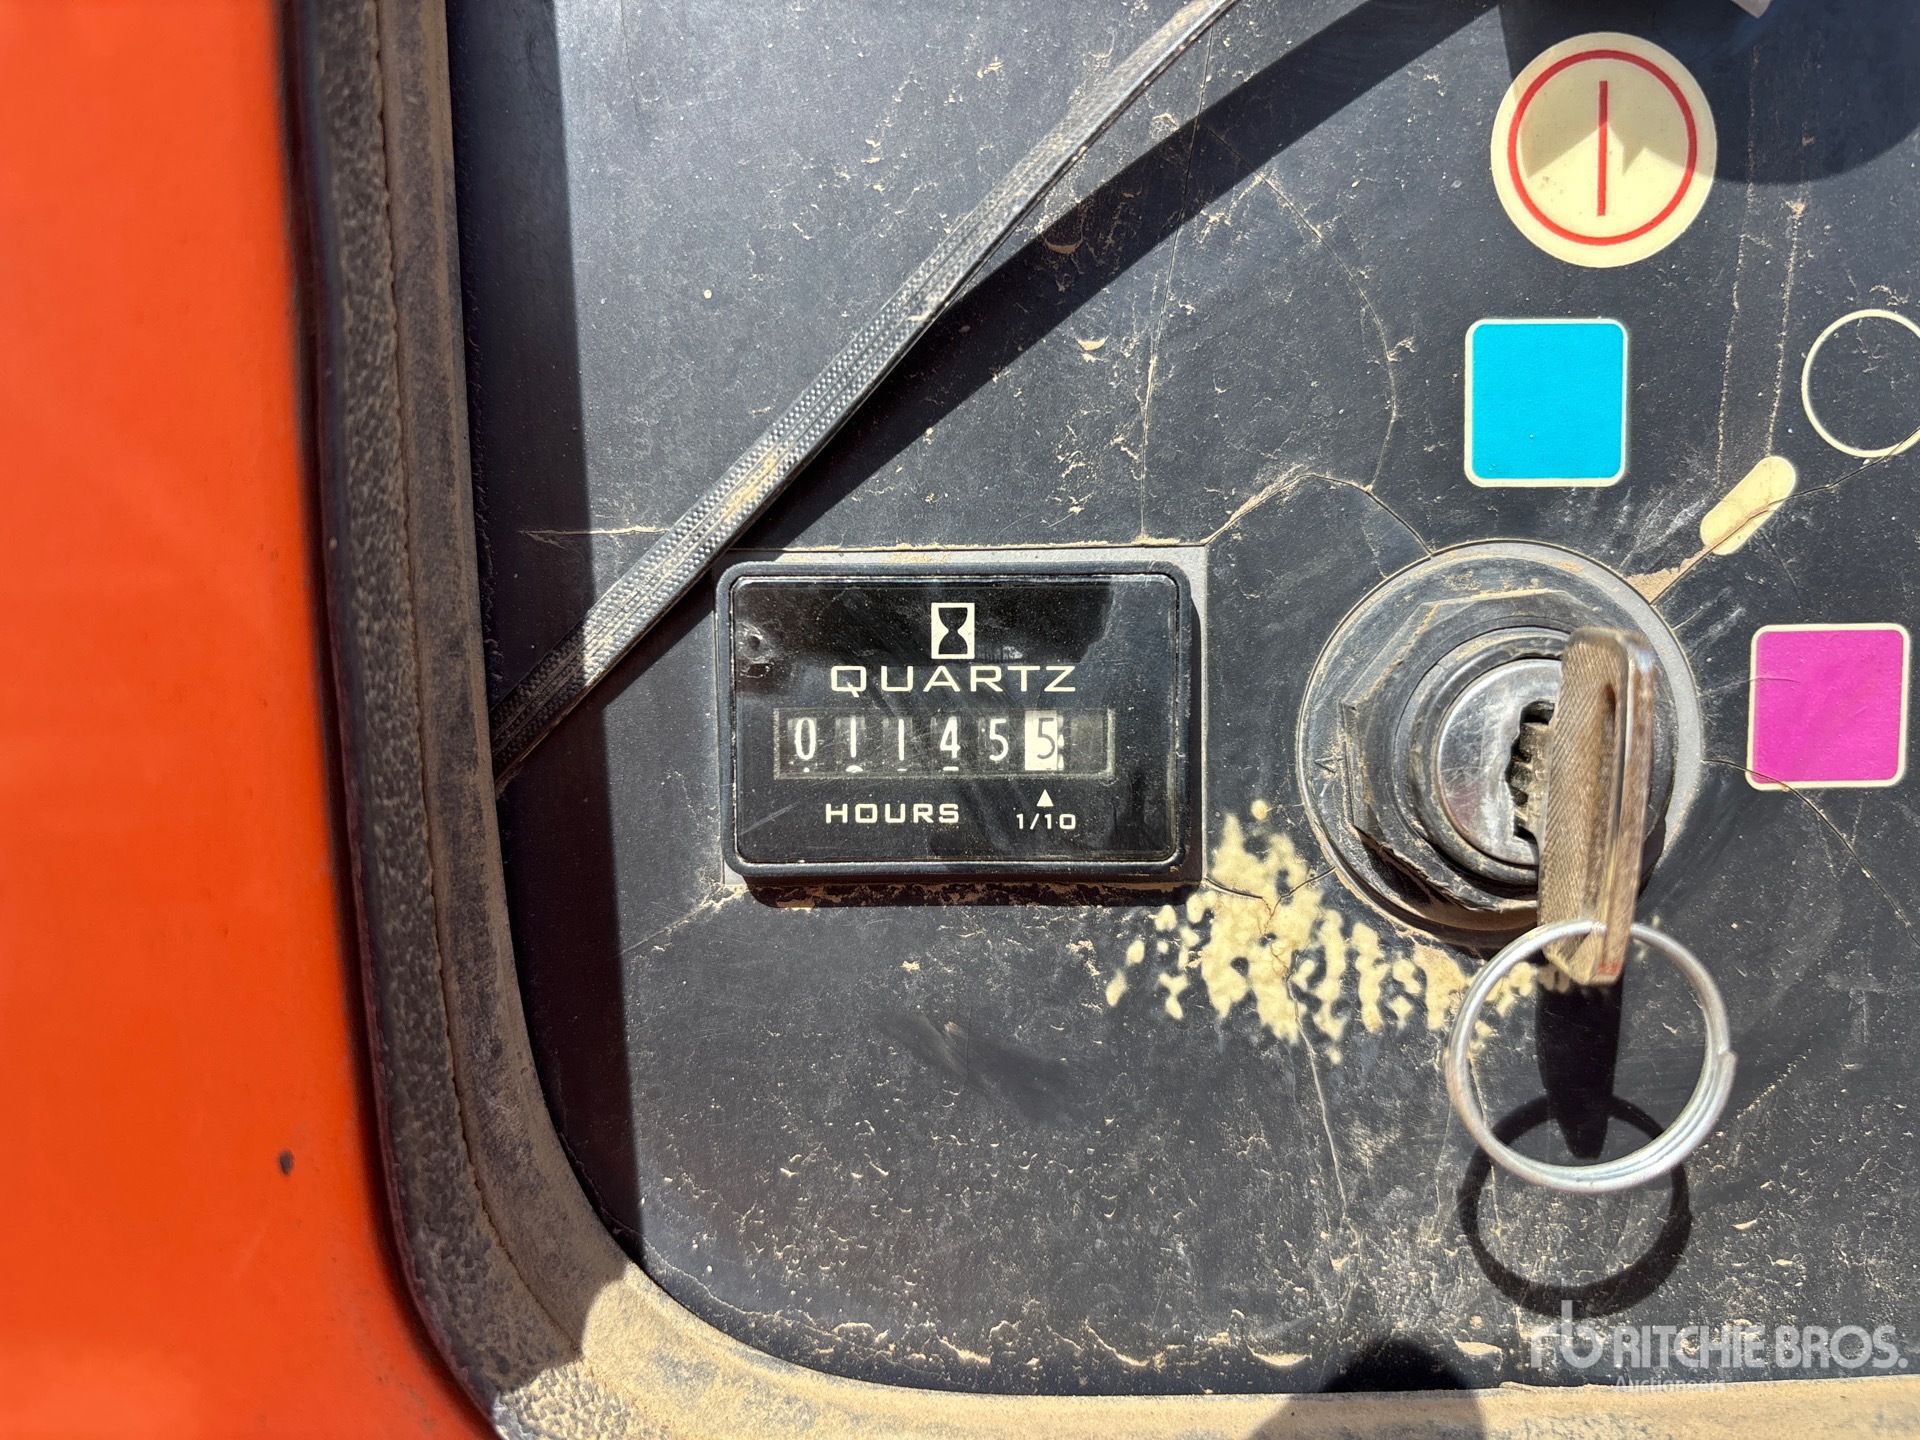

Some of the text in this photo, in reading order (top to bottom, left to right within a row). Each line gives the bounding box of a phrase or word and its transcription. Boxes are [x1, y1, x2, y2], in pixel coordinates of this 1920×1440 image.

[830, 665, 1077, 697] QUARTZ
[825, 802, 960, 824] HOURS
[1016, 812, 1076, 830] 1/10
